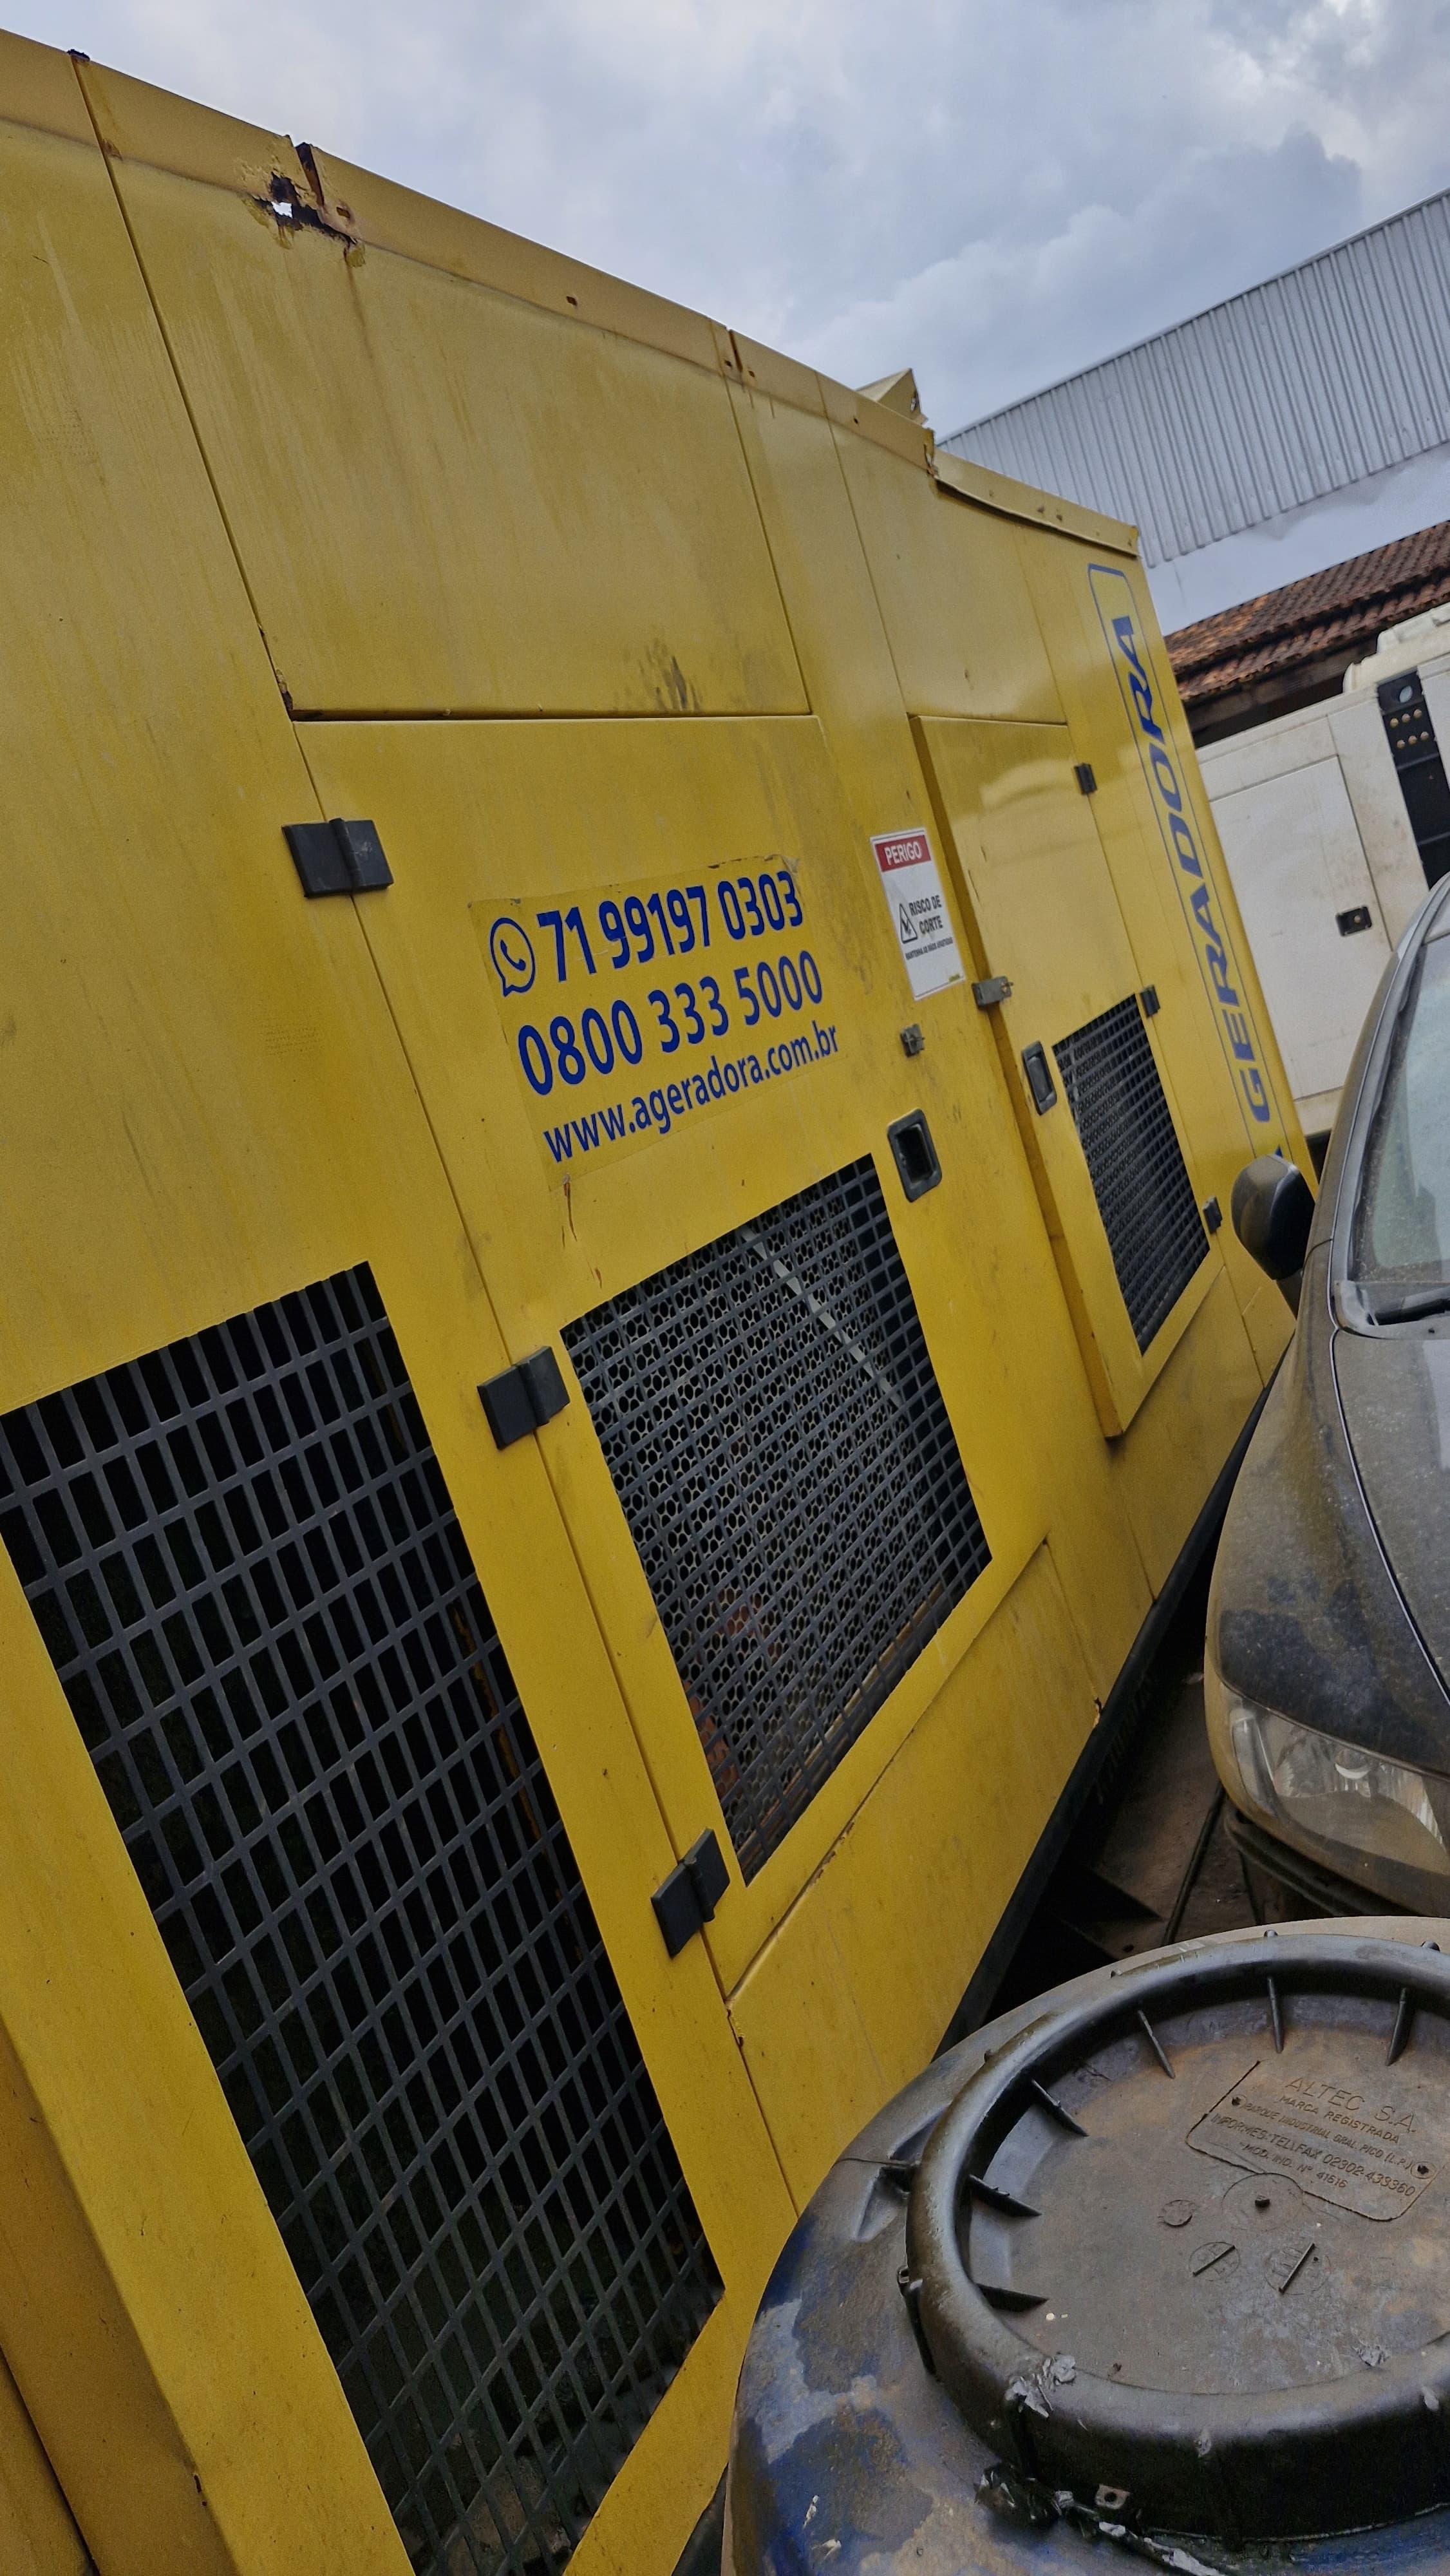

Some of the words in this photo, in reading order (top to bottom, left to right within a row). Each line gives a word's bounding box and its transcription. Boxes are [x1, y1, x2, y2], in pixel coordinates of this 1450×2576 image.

[884, 841, 922, 866] PERIGO
[1112, 614, 1270, 1122] GERADORA
[537, 906, 597, 983] 71
[599, 885, 710, 969] 99197
[717, 871, 804, 940] 0303
[909, 897, 931, 916] RISCO
[931, 895, 942, 909] DE
[919, 915, 943, 934] CORTE
[518, 999, 642, 1095] 0800
[648, 976, 729, 1053] 333
[734, 950, 822, 1026] 5000
[543, 1020, 838, 1162] www.ageradora.com.br
[1277, 2095, 1319, 2114] MARCA
[1324, 2111, 1399, 2143] REGISTRADA
[1285, 2077, 1365, 2110] ALTEC
[1374, 2105, 1417, 2133] S.A.
[1278, 2115, 1331, 2139] INDUSTRIAL
[1359, 2144, 1384, 2158] PICO
